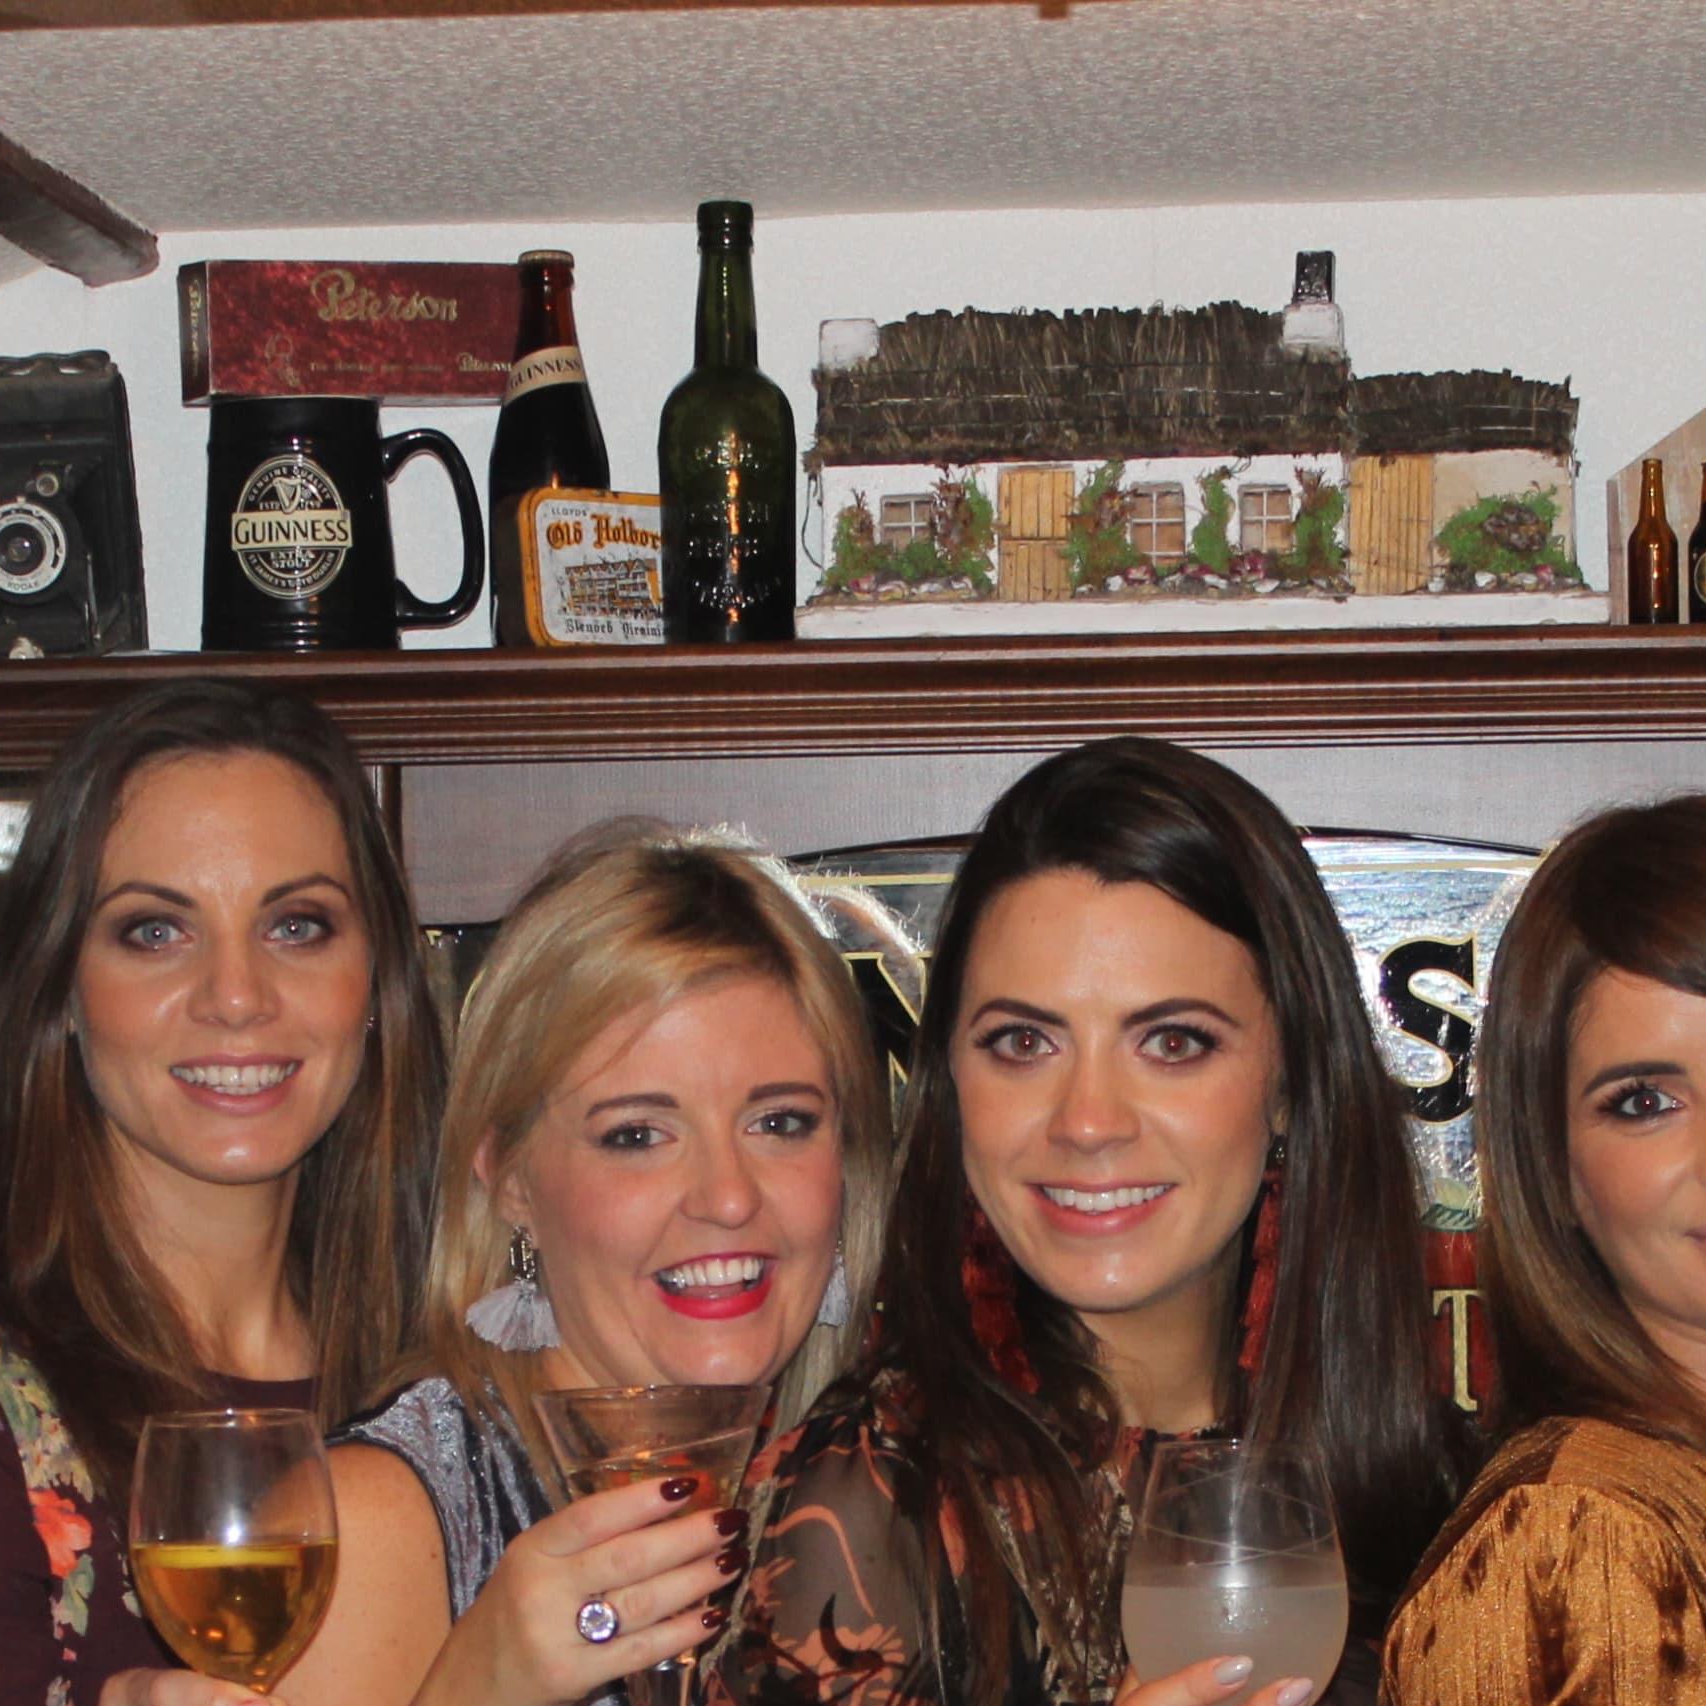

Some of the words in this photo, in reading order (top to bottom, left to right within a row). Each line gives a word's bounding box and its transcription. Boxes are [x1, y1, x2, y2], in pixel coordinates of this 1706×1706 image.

[310, 268, 459, 321] Peterson
[248, 467, 288, 501] GENUINE
[293, 468, 332, 500] QUALITY
[551, 507, 588, 517] LLOYDS
[234, 518, 349, 545] GUINNESS
[547, 520, 583, 549] Old
[590, 514, 662, 549] Holbor
[270, 551, 316, 560] EXTRA
[272, 560, 311, 568] STOUT
